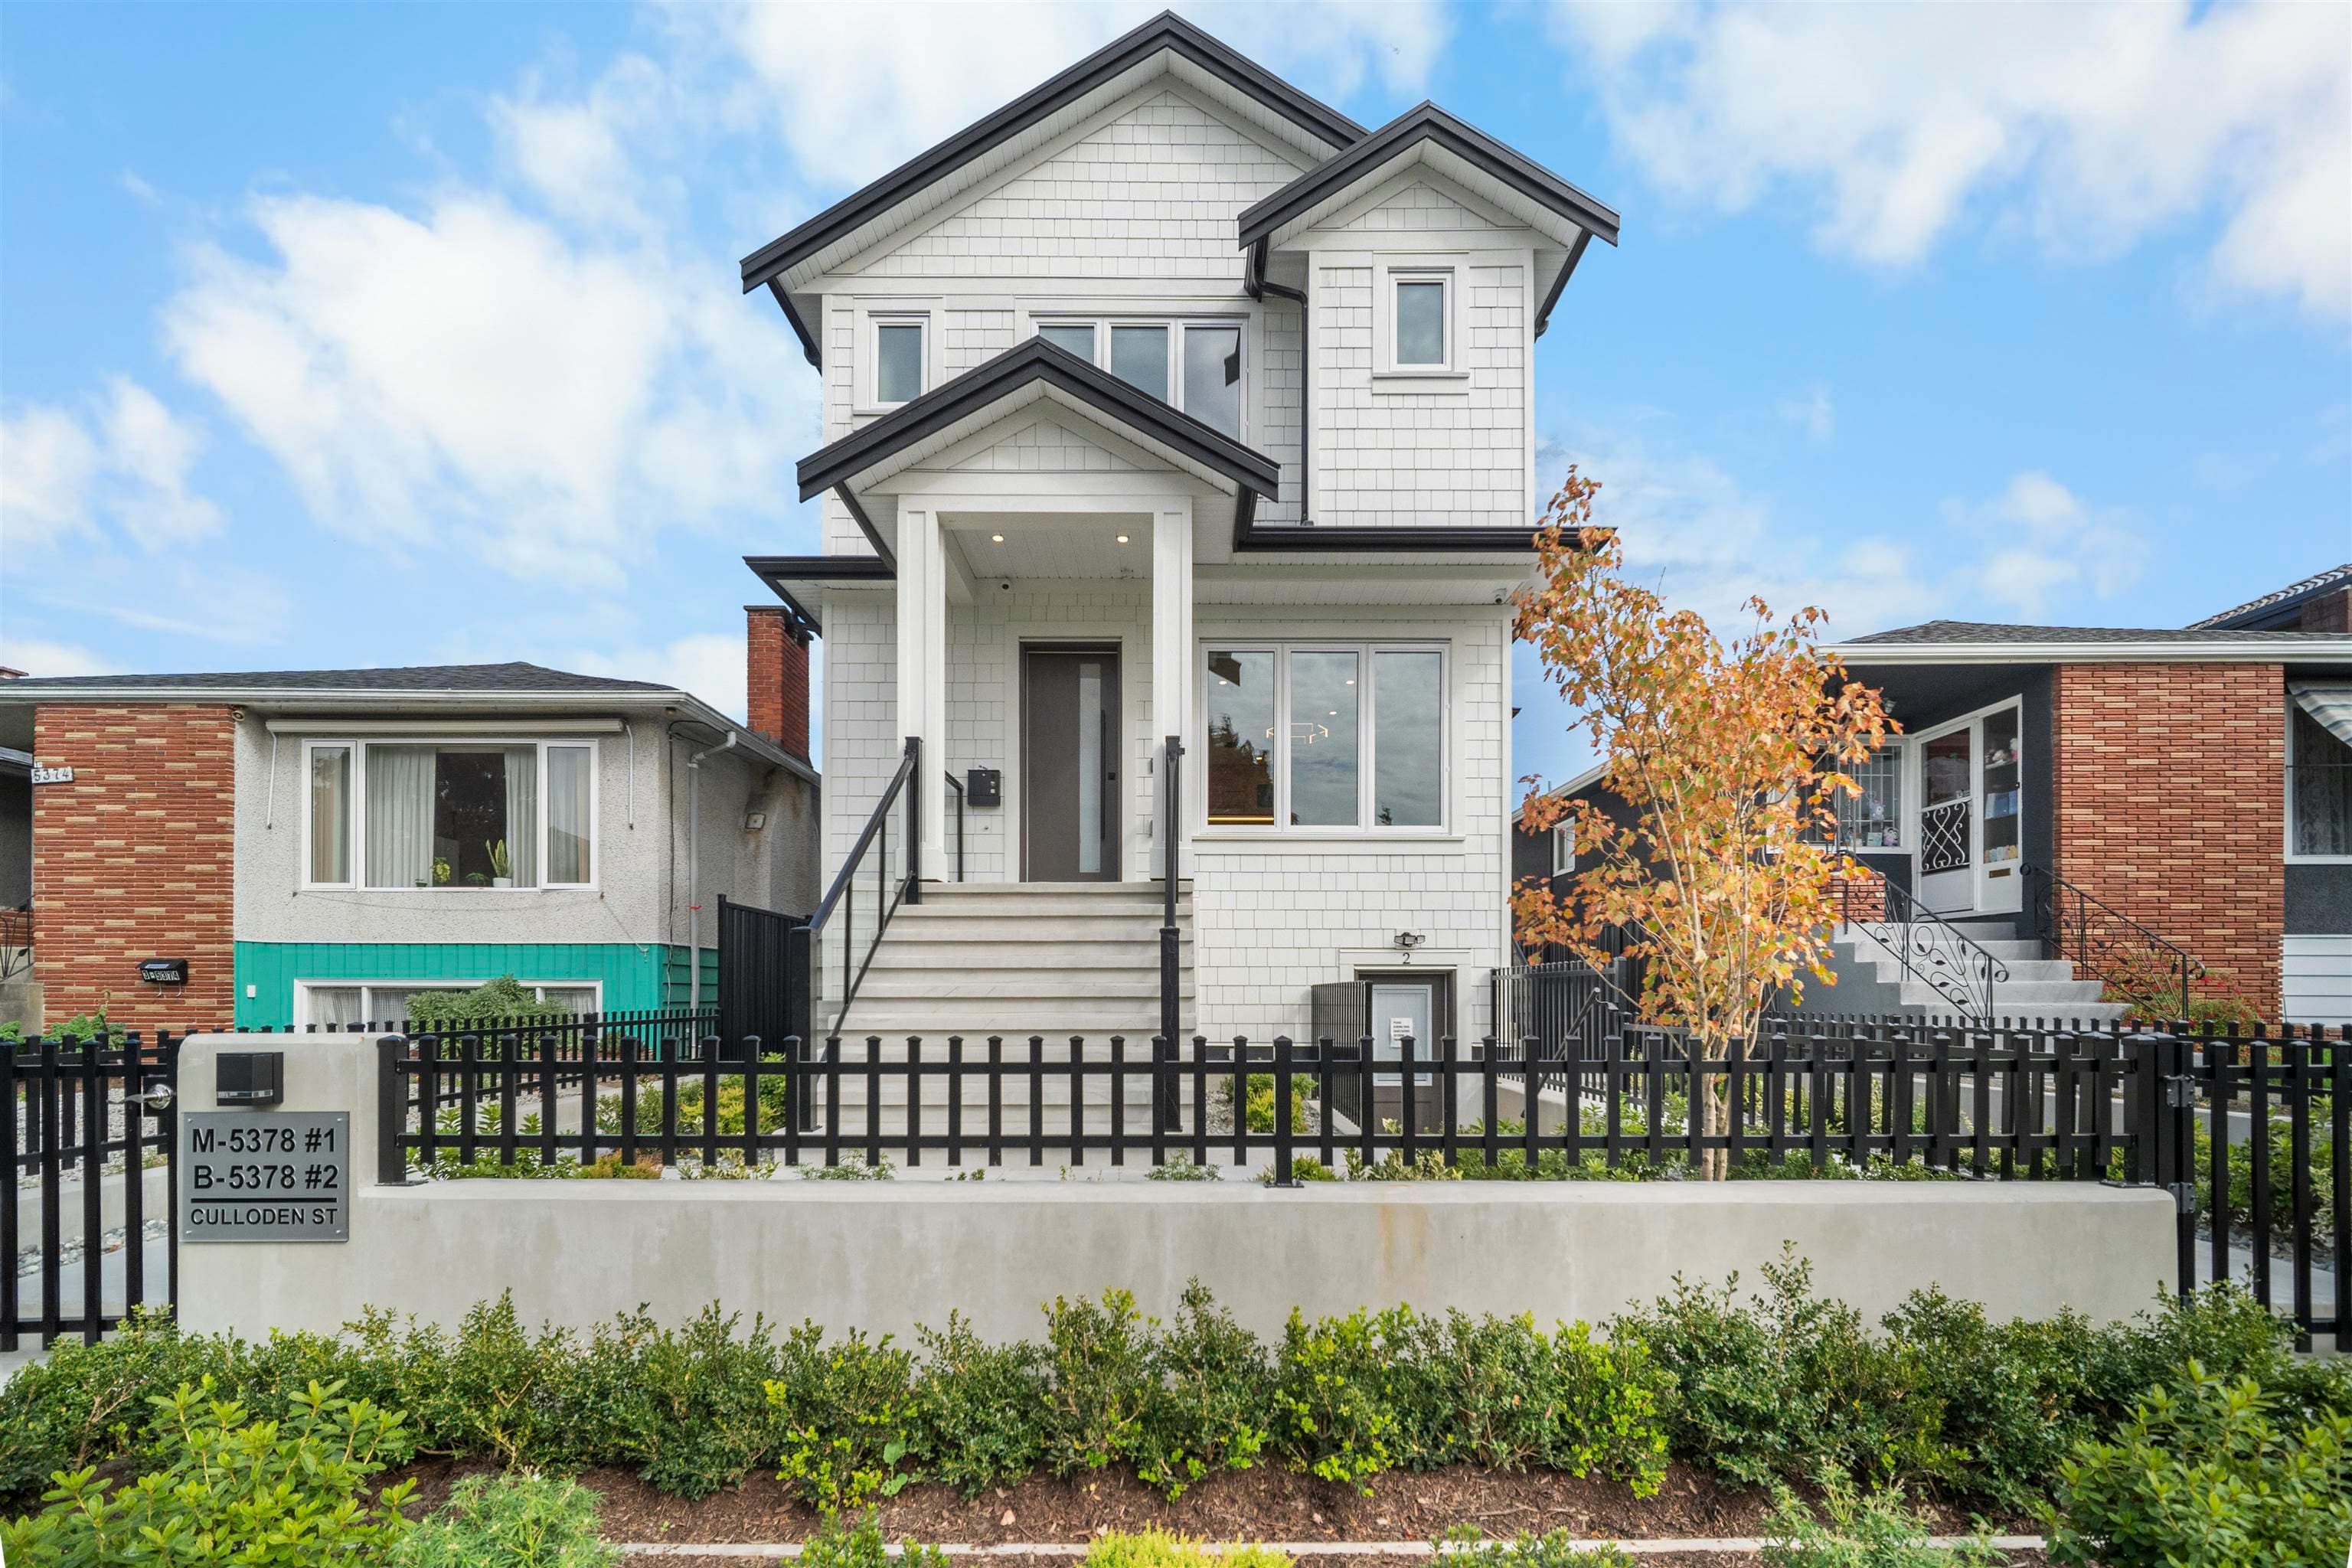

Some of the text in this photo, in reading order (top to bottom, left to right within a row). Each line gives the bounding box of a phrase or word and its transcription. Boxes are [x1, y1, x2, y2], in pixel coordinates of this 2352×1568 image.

[34, 768, 70, 781] 5374
[1403, 952, 1410, 964] 2
[192, 1128, 335, 1153] M-5378 #1
[194, 1165, 338, 1189] B-5378 #2
[191, 1208, 338, 1225] CULLODEN ST
